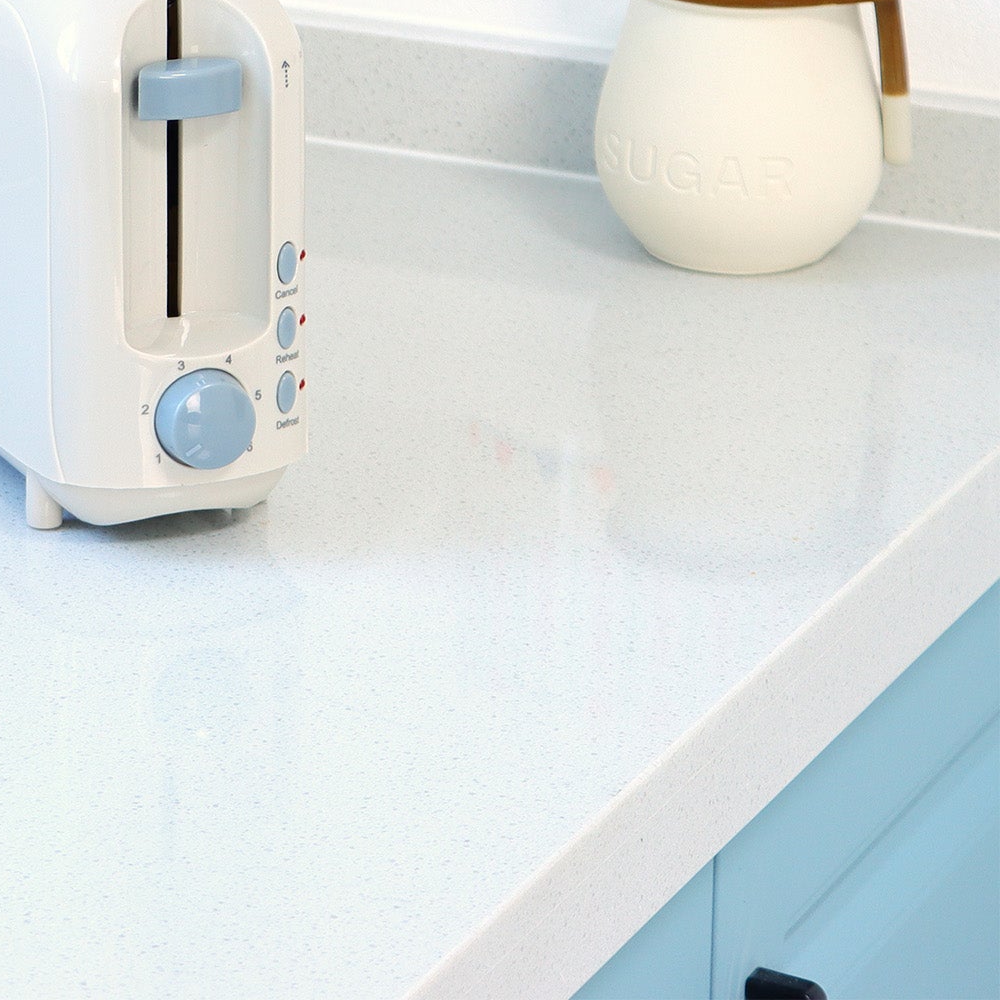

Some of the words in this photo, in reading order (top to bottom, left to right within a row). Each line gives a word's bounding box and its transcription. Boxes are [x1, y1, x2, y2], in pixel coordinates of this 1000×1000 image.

[602, 129, 794, 201] SUGAR
[274, 285, 298, 299] Cancel
[225, 355, 232, 364] 4
[276, 350, 299, 364] Reheat
[178, 361, 185, 371] 3
[255, 390, 262, 400] 5
[141, 404, 149, 415] 2
[276, 416, 299, 430] Defrost
[156, 453, 161, 463] 1
